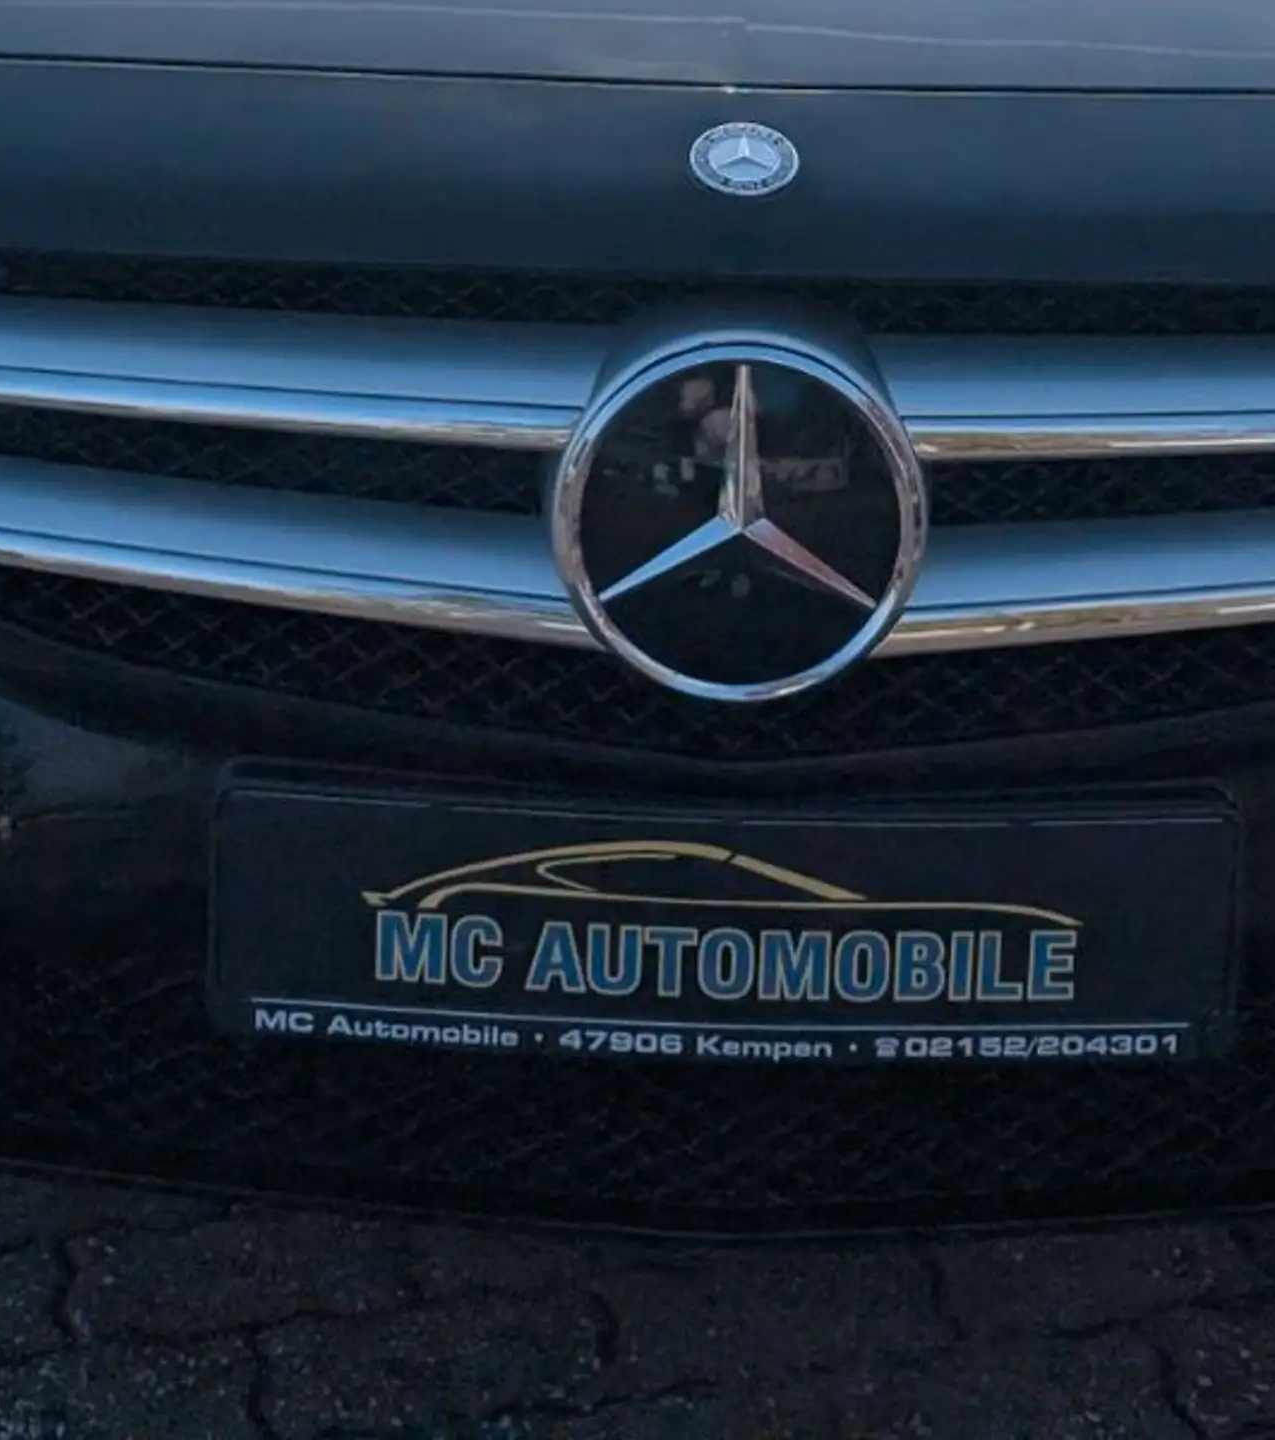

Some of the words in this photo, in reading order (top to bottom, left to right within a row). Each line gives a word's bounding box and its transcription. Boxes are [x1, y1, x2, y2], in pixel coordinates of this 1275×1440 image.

[375, 909, 505, 988] MC
[525, 921, 1078, 1002] AUTOMOBILE
[254, 1008, 315, 1034] MC
[326, 1012, 519, 1048] Automobile
[558, 1030, 683, 1055] 47906
[696, 1035, 833, 1062] Kempen
[904, 1033, 1179, 1058] 02152/204301
